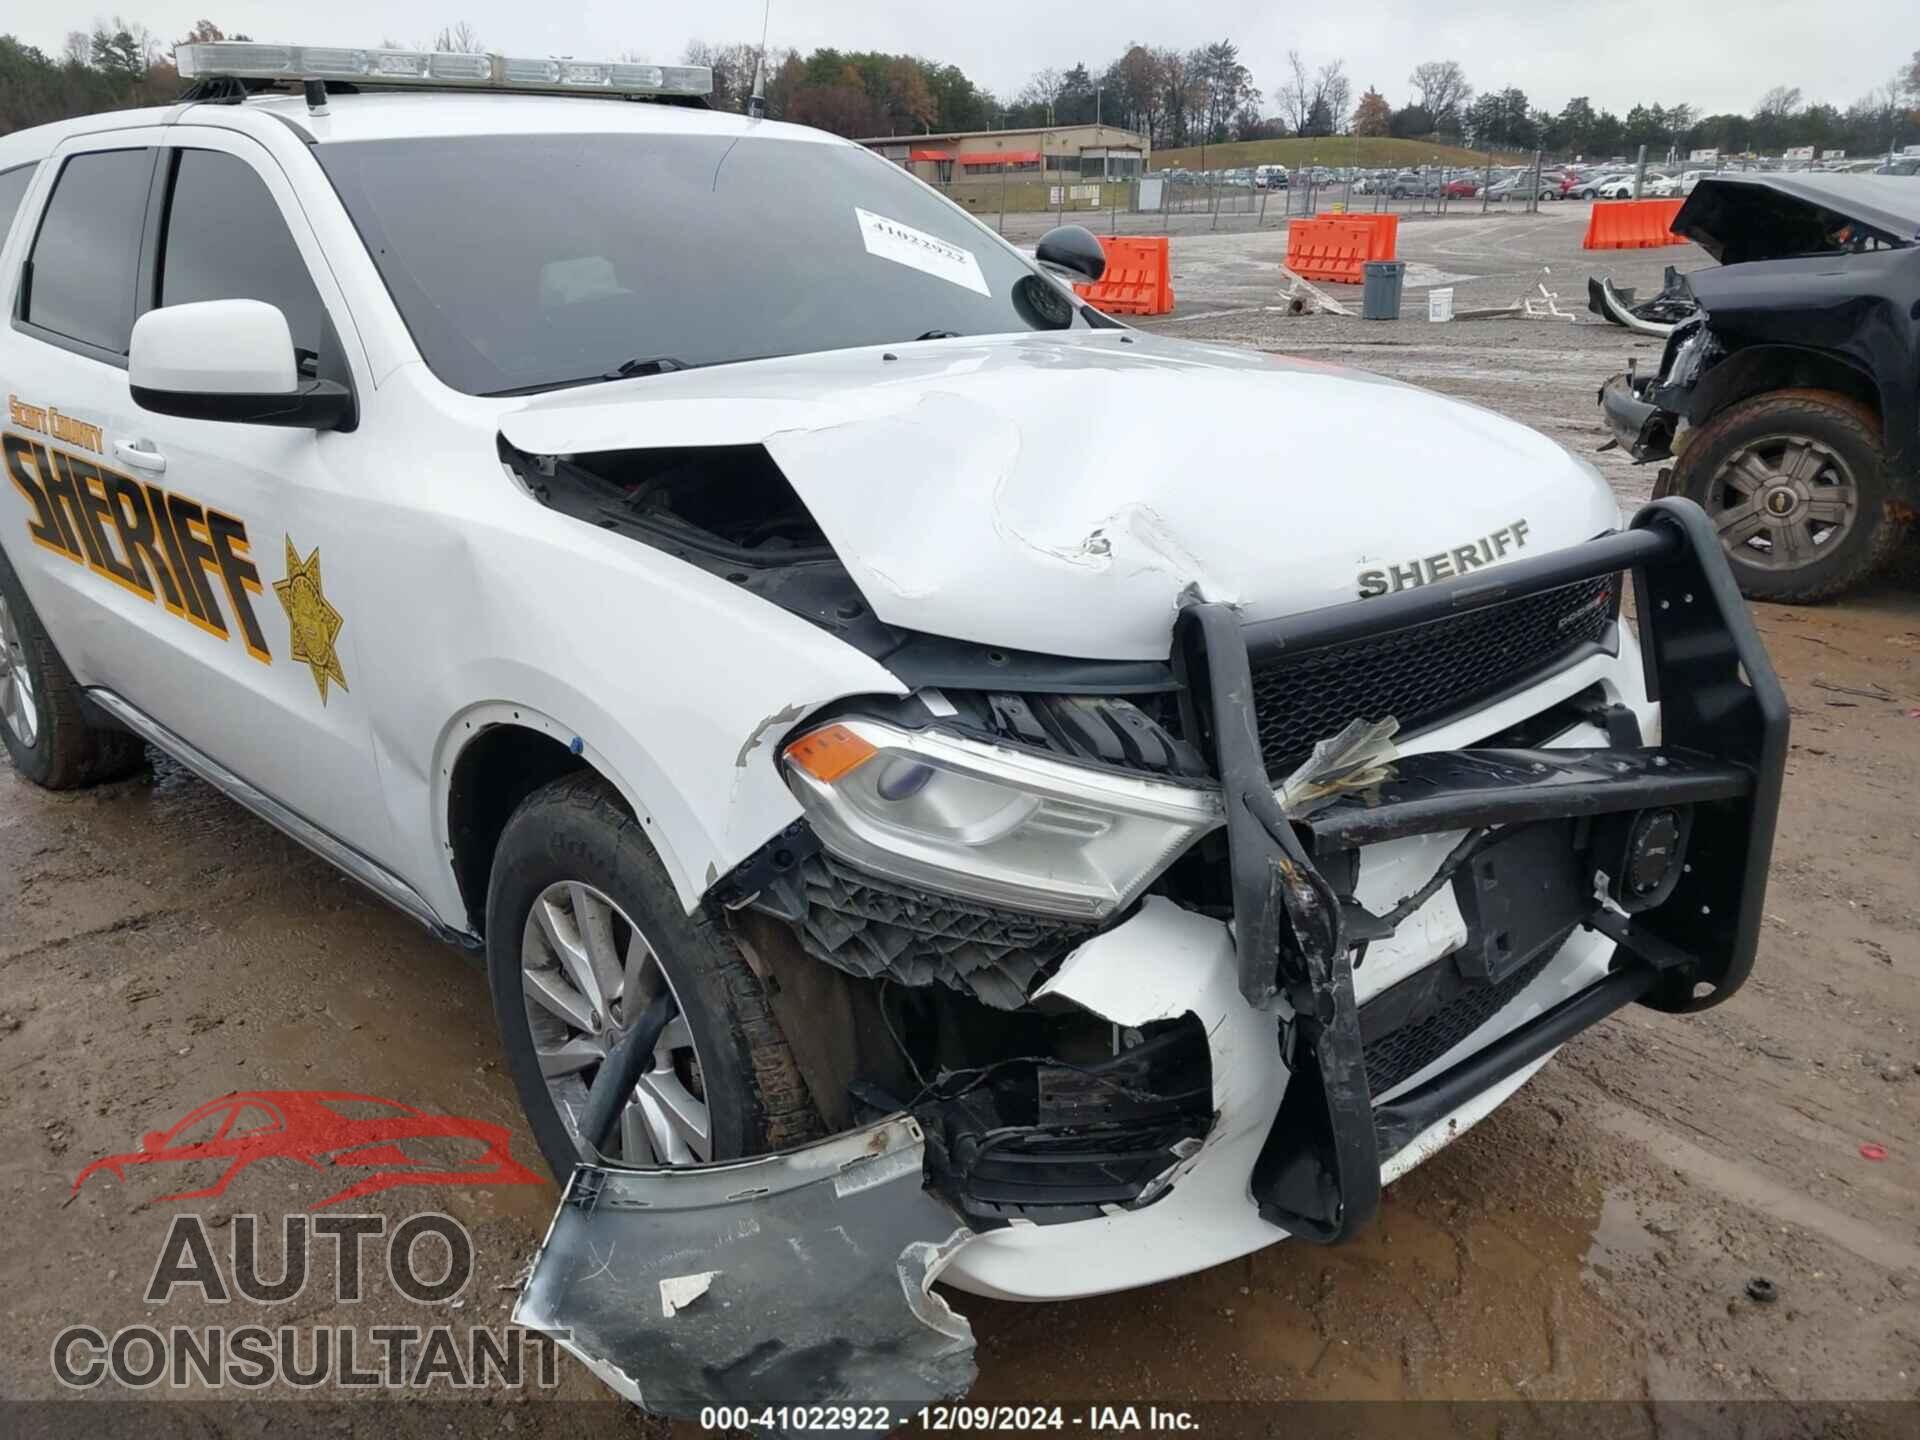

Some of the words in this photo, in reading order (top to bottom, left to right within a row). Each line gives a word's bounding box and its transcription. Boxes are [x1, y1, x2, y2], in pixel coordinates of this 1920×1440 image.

[872, 222, 968, 265] 41022922
[2, 431, 272, 665] SHERIFF
[1358, 518, 1529, 598] SHERIFF
